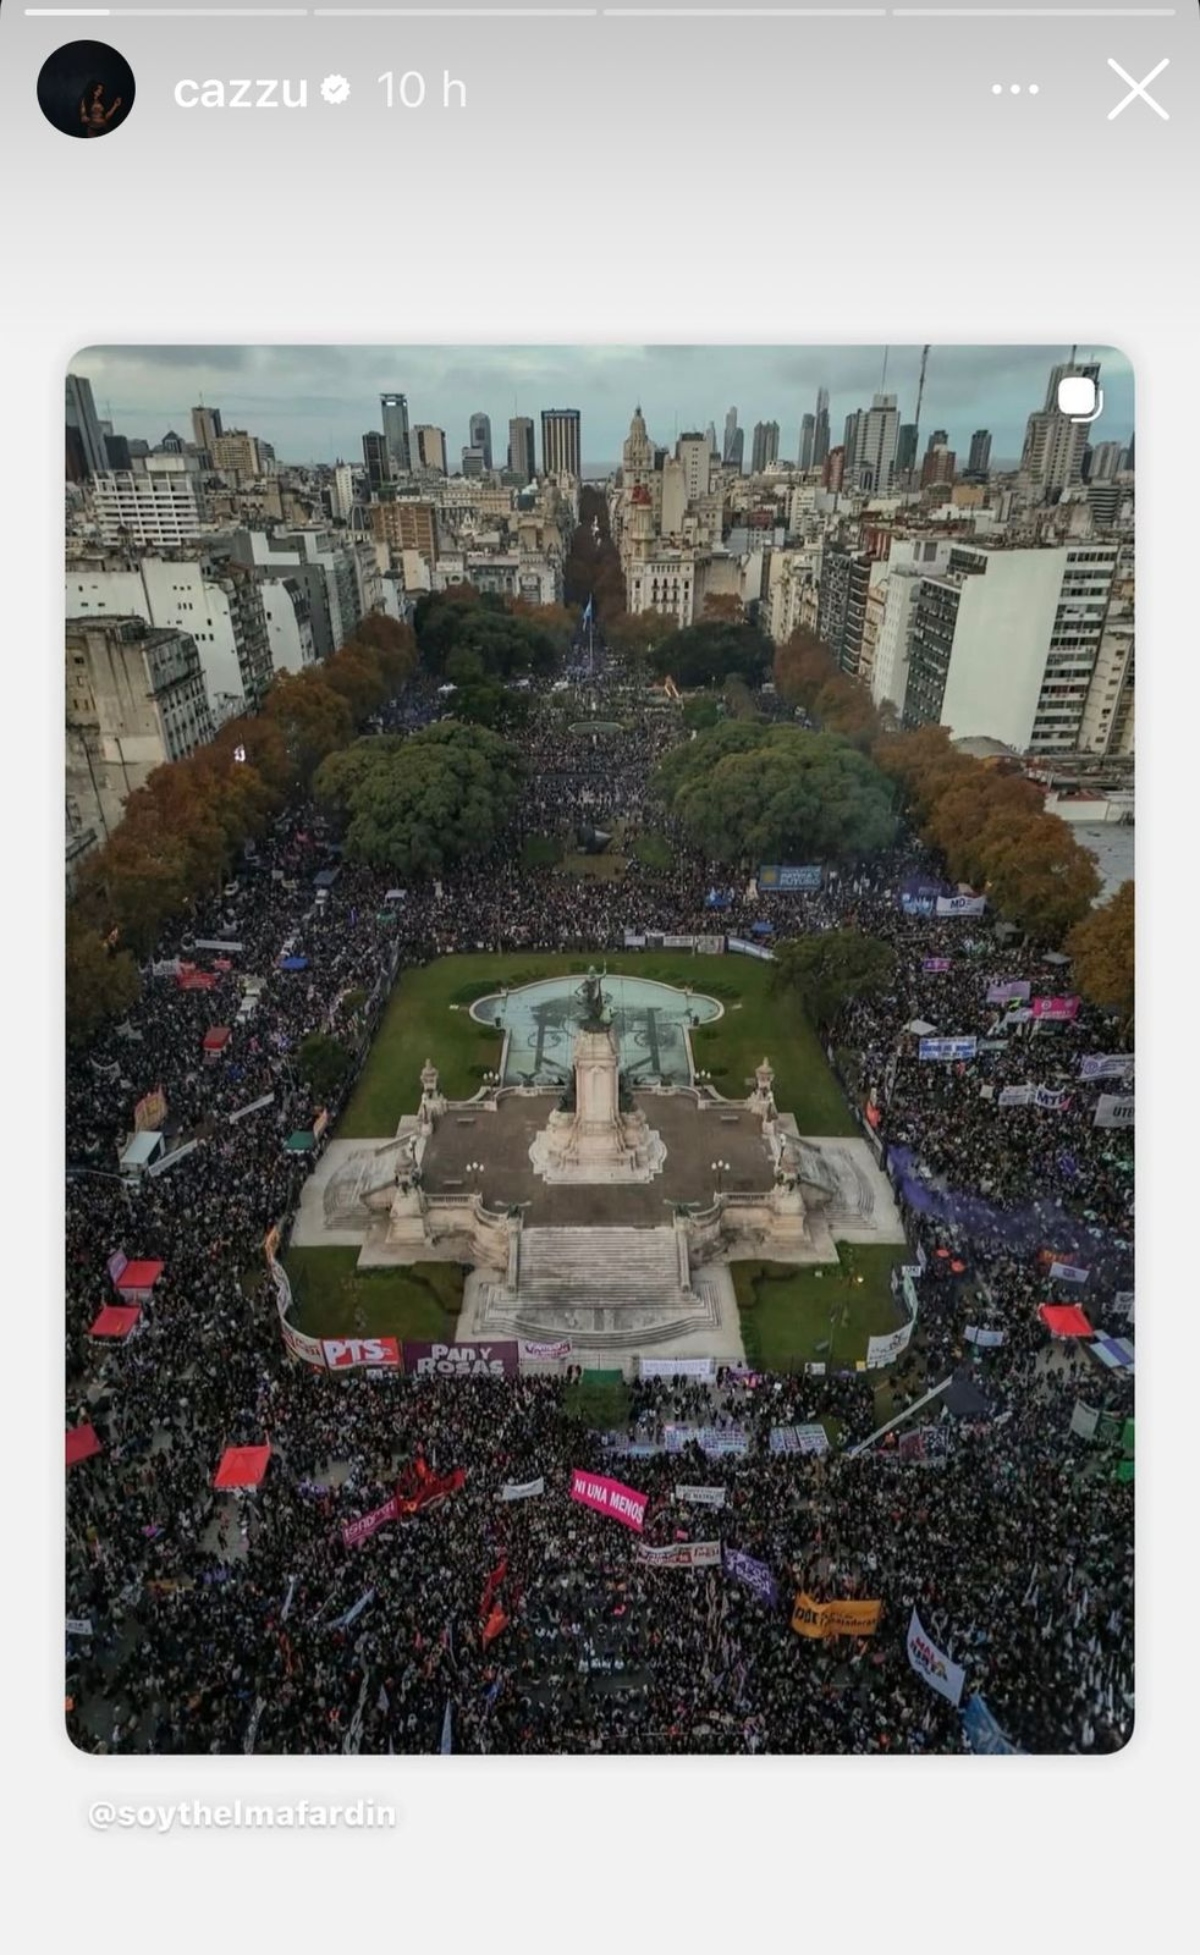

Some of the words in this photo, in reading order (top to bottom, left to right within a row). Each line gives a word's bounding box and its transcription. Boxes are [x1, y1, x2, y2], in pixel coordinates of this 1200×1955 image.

[323, 1338, 383, 1366] PTS
[479, 1347, 493, 1360] Y
[417, 1357, 505, 1375] ROSAS
[574, 1479, 586, 1495] NI
[587, 1483, 607, 1505] UNA
[609, 1491, 646, 1525] MENOS
